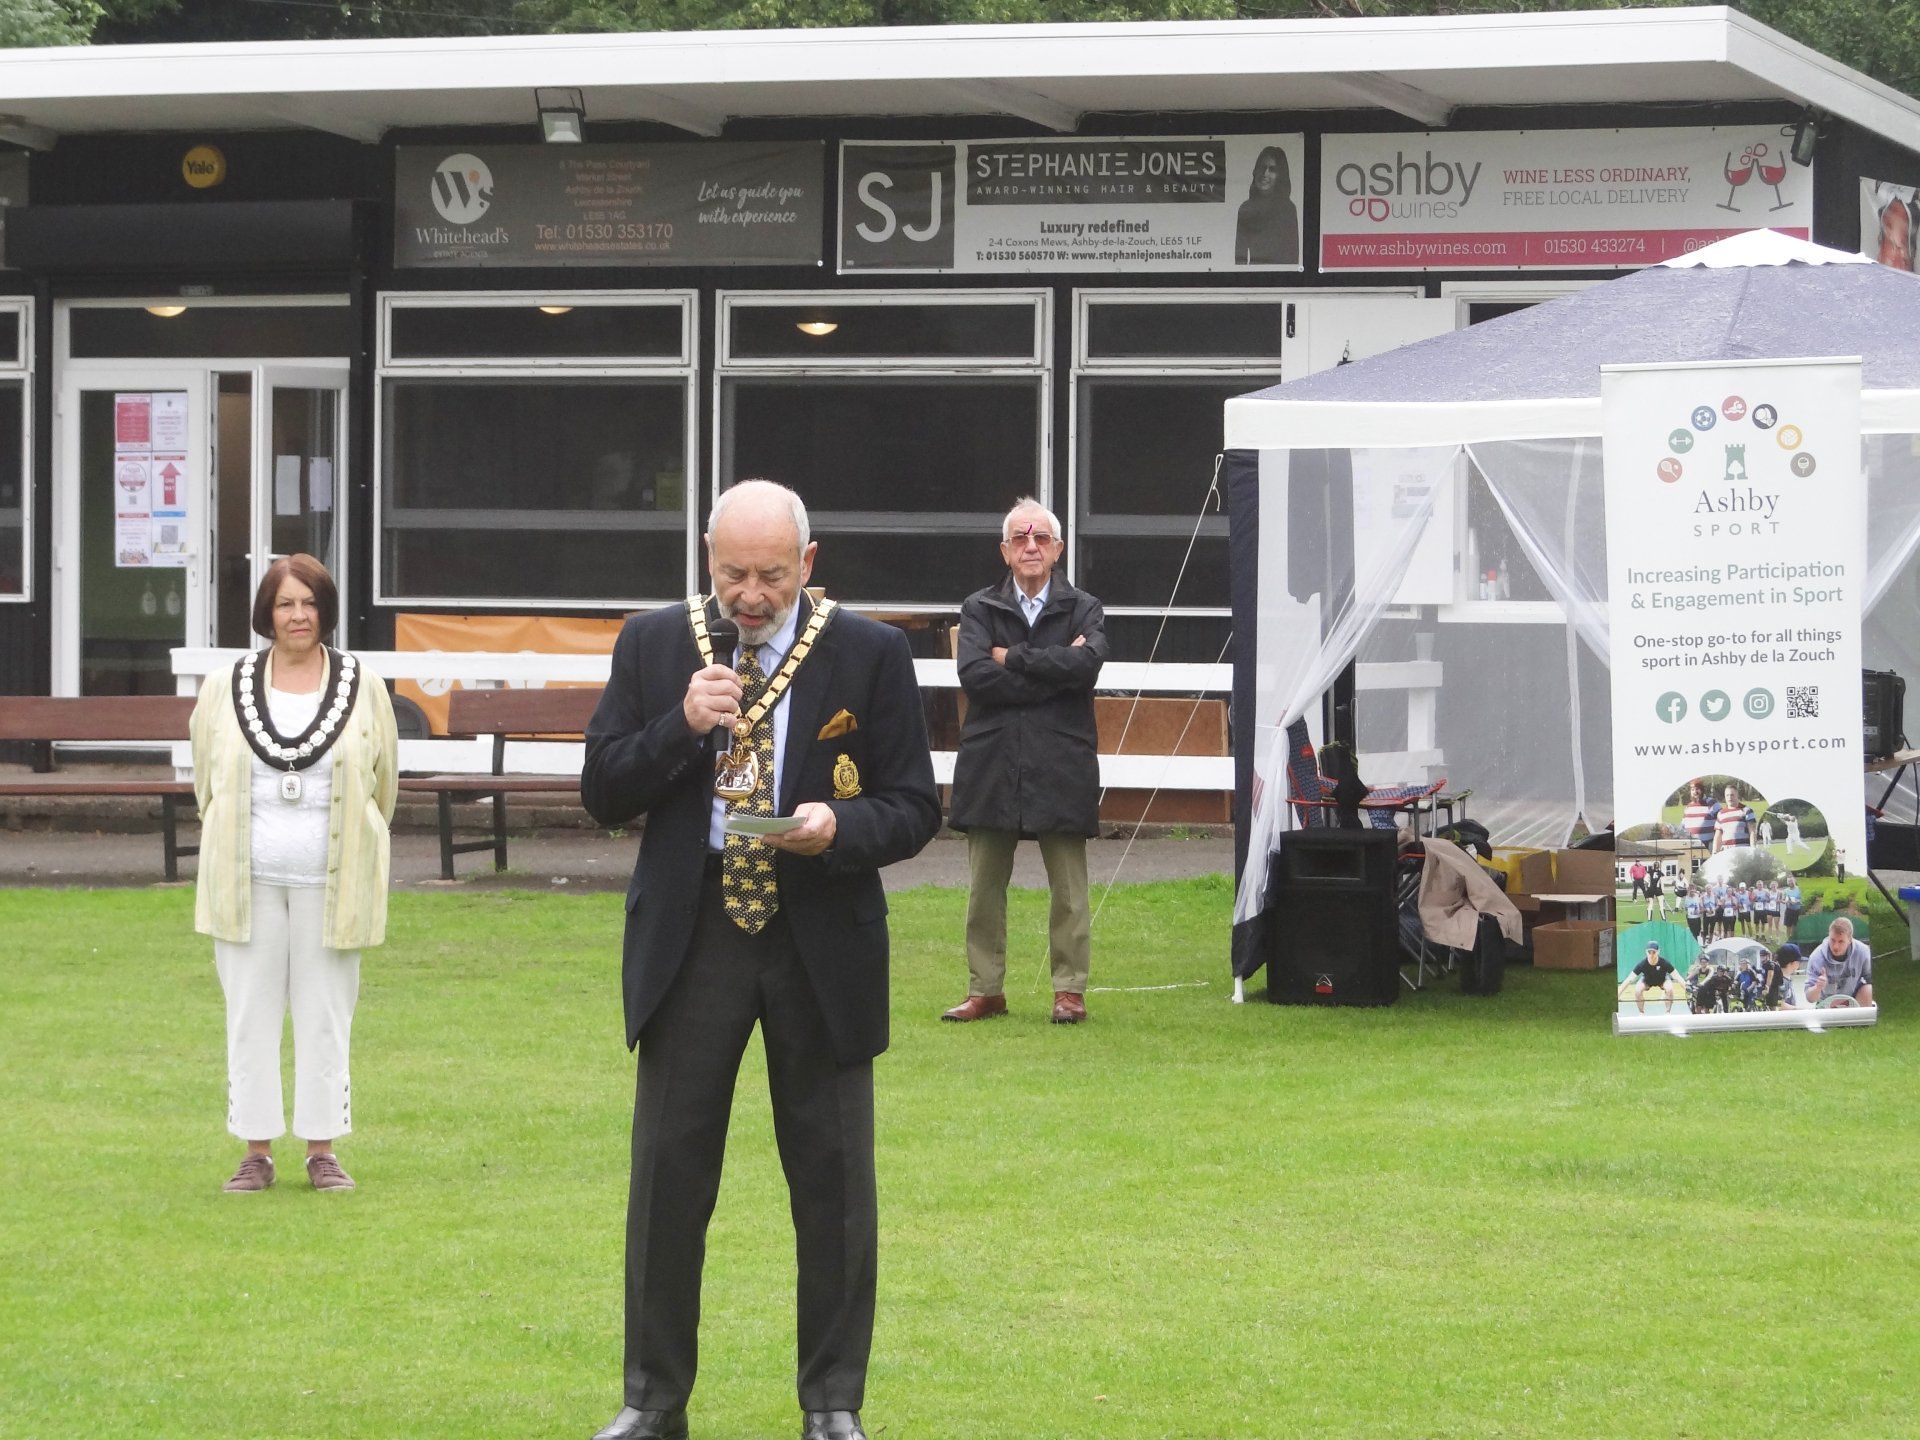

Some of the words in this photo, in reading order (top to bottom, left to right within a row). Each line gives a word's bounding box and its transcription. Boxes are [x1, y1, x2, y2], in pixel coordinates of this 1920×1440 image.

[186, 160, 214, 175] Yale
[976, 152, 1129, 178] STEPHANIE
[1132, 151, 1216, 176] JONES
[1335, 150, 1482, 208] ashby
[1503, 169, 1549, 185] WINE
[1552, 169, 1595, 184] LESS
[1599, 166, 1692, 184] ORDINARY,
[698, 181, 719, 201] Let
[720, 187, 736, 199] us
[737, 181, 777, 209] guide
[778, 187, 805, 205] you
[976, 184, 1090, 195] AWARD-WINNING
[1101, 184, 1134, 194] HAIR
[1145, 184, 1153, 193] &
[1163, 183, 1216, 193] BEAUTY
[1503, 191, 1545, 206] FREE
[1550, 190, 1603, 206] LOCAL
[1607, 188, 1690, 204] DELIVERY
[698, 206, 731, 224] with
[731, 210, 798, 227] experience
[855, 171, 942, 243] SJ
[1391, 201, 1459, 219] wines
[415, 227, 510, 244] Whitehead's
[566, 223, 614, 239] 01530
[618, 223, 674, 239] 353170
[1040, 221, 1085, 236] Luxury
[1088, 219, 1150, 234] redefined
[988, 238, 1003, 247] 2-4
[1005, 238, 1039, 247] Coxons
[1041, 238, 1070, 247] Mews,
[1071, 236, 1158, 248] Ashby-de-la-Zouch,
[1160, 236, 1183, 246] LE65
[1186, 236, 1203, 245] 1LF
[1337, 239, 1507, 259] www.ashbywines.com
[1544, 239, 1587, 254] 01530
[1591, 238, 1646, 253] 433274
[976, 252, 984, 261] T:
[986, 251, 1016, 261] 01530
[1018, 251, 1055, 260] 560570
[1057, 251, 1070, 260] W:
[1071, 249, 1212, 262] www.stephaniejoneshair.com
[1693, 487, 1780, 519] Ashby
[1693, 521, 1780, 537] SPORT
[1627, 565, 1721, 585] Increasing
[1727, 561, 1845, 581] Participation
[1631, 593, 1646, 609] &
[1651, 589, 1765, 611] Engagement
[1770, 587, 1787, 604] in
[1793, 586, 1844, 606] Sport
[1633, 633, 1703, 649] One-stop
[1707, 631, 1747, 648] go-to
[1752, 630, 1772, 643] for
[1776, 628, 1793, 642] all
[1797, 628, 1842, 644] things
[1641, 655, 1681, 670] sport
[1684, 653, 1698, 667] in
[1701, 651, 1746, 667] Ashby
[1750, 650, 1768, 664] de
[1772, 649, 1785, 663] la
[1789, 647, 1836, 663] Zouch
[1634, 735, 1847, 757] www.ashbysport.com
